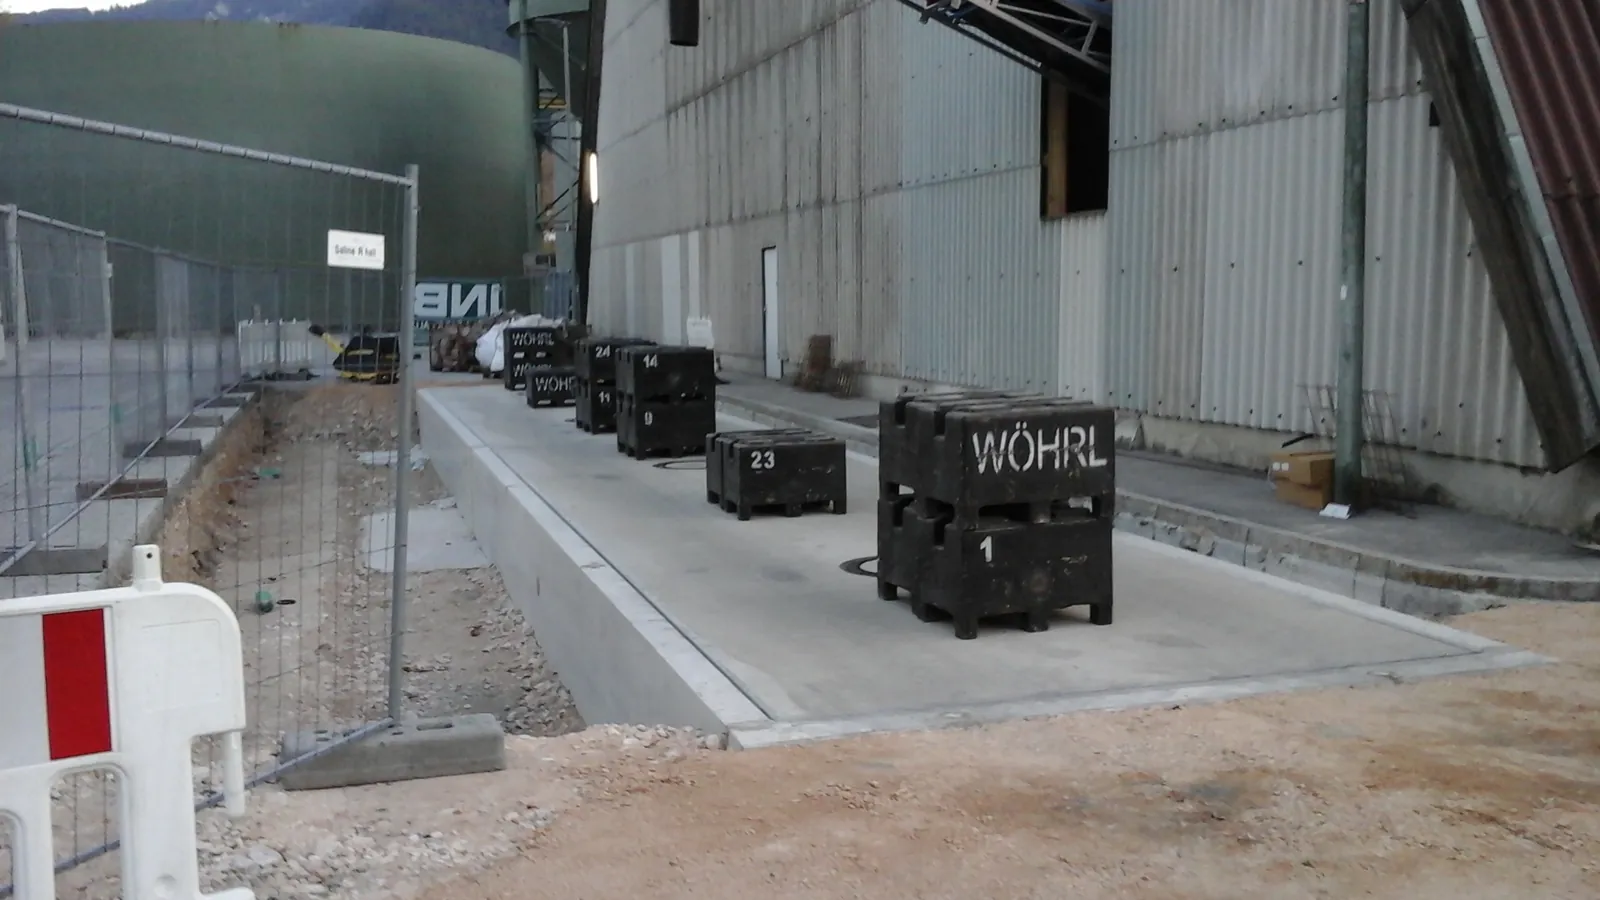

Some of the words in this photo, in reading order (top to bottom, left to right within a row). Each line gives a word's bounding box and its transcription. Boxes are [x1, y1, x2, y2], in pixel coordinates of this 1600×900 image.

[595, 344, 611, 358] 24
[643, 354, 658, 369] 14
[972, 421, 1108, 474] WÖHRL
[750, 450, 775, 469] 23
[979, 535, 993, 563] 1
